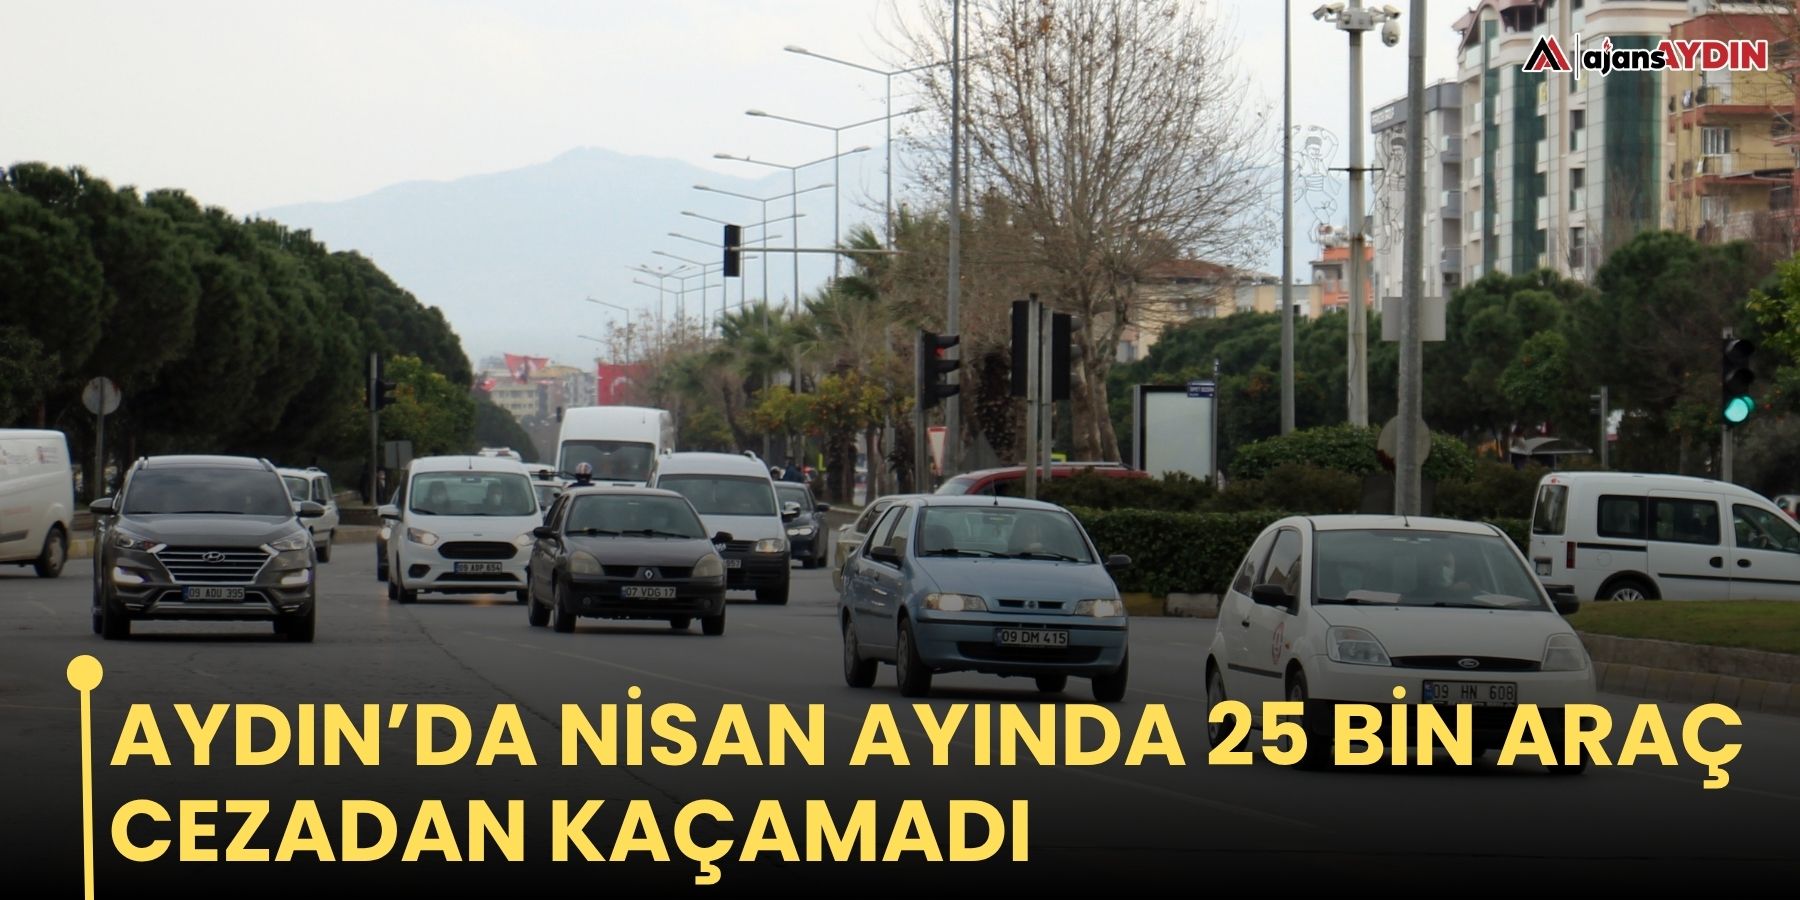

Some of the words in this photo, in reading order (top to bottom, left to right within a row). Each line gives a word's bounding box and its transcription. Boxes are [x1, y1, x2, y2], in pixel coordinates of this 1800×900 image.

[189, 588, 200, 598] 09
[226, 588, 243, 598] 395
[627, 587, 638, 597] 07
[641, 587, 661, 598] VDG
[664, 588, 674, 598] 17
[1002, 630, 1018, 642] 09
[1021, 631, 1040, 644] DM
[1043, 632, 1066, 645] 415
[1433, 684, 1449, 699] 09
[1461, 685, 1478, 699] HN
[1489, 685, 1514, 700] 608
